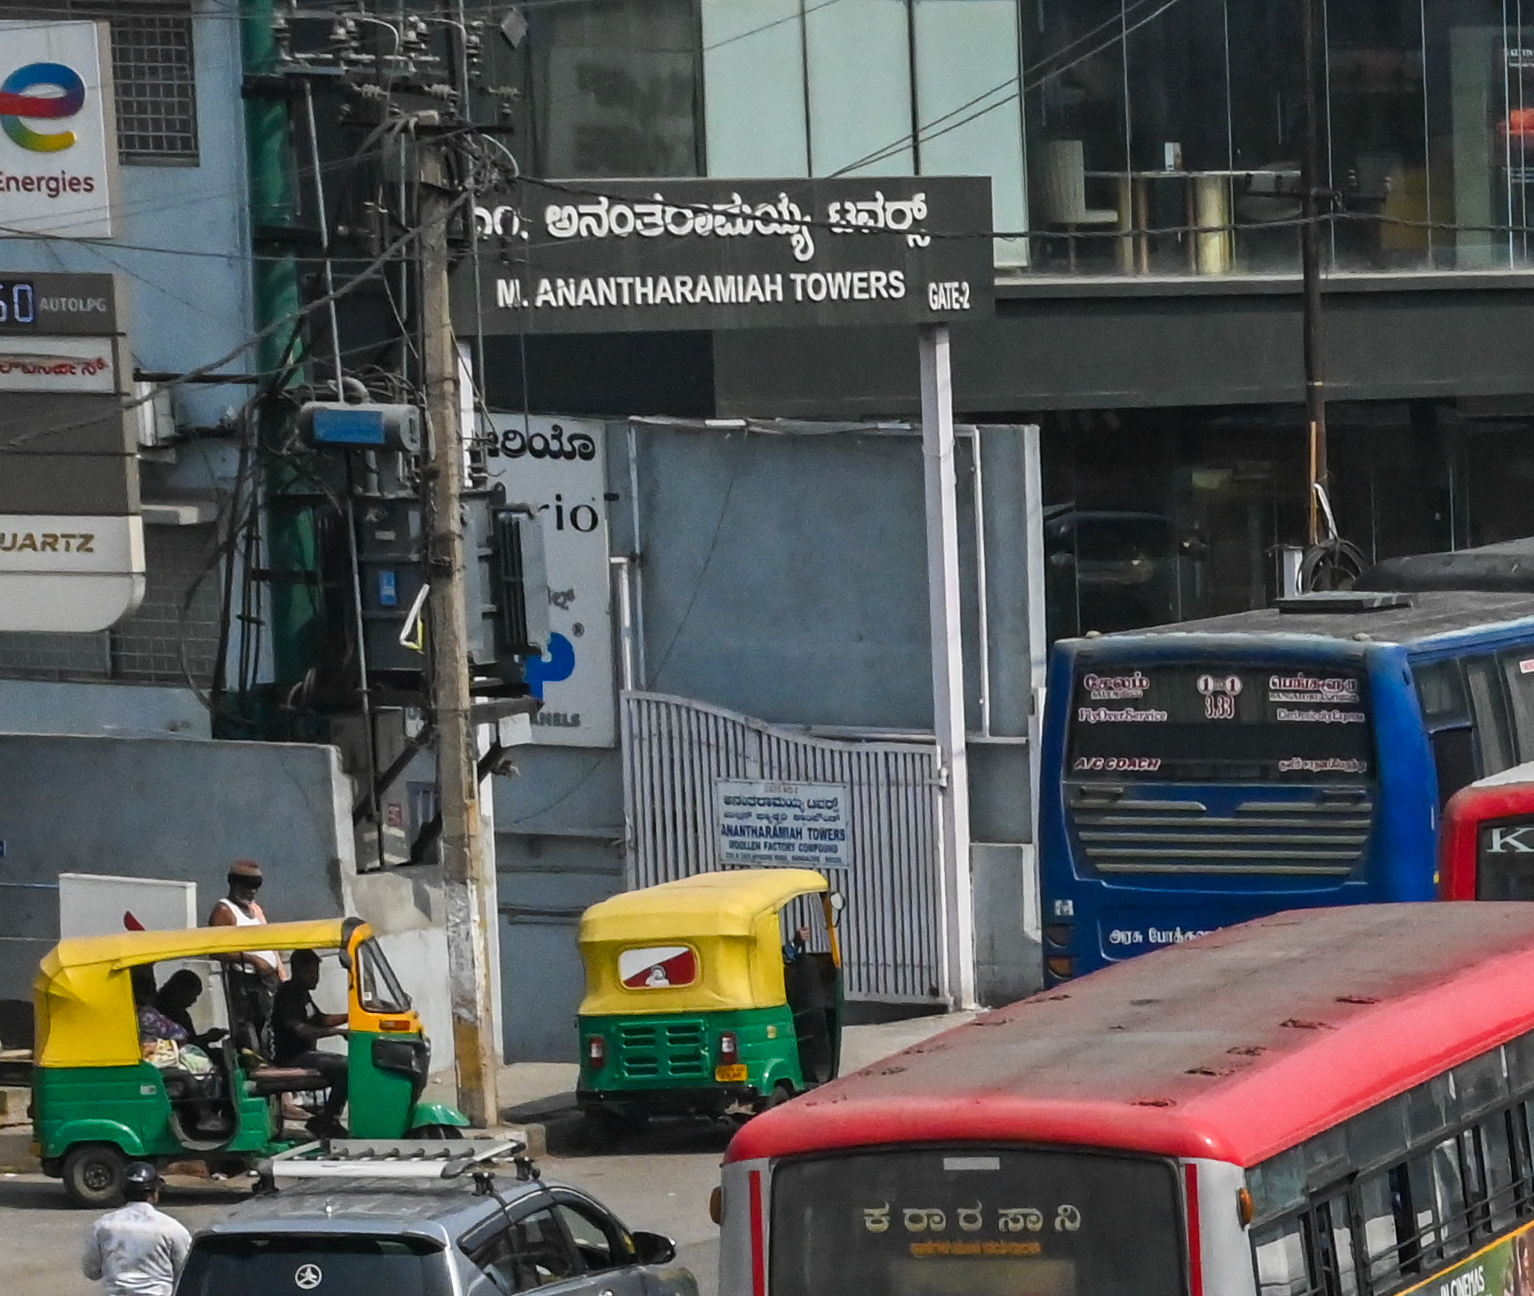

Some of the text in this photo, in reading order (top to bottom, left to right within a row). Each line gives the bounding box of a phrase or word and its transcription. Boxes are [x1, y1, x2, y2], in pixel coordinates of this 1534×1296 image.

[535, 272, 784, 308] ANANTHARAMIAH
[789, 270, 906, 302] TOWERS
[928, 281, 971, 311] GATE-2
[721, 823, 846, 841] ANANTHARAMIAH TOWERS
